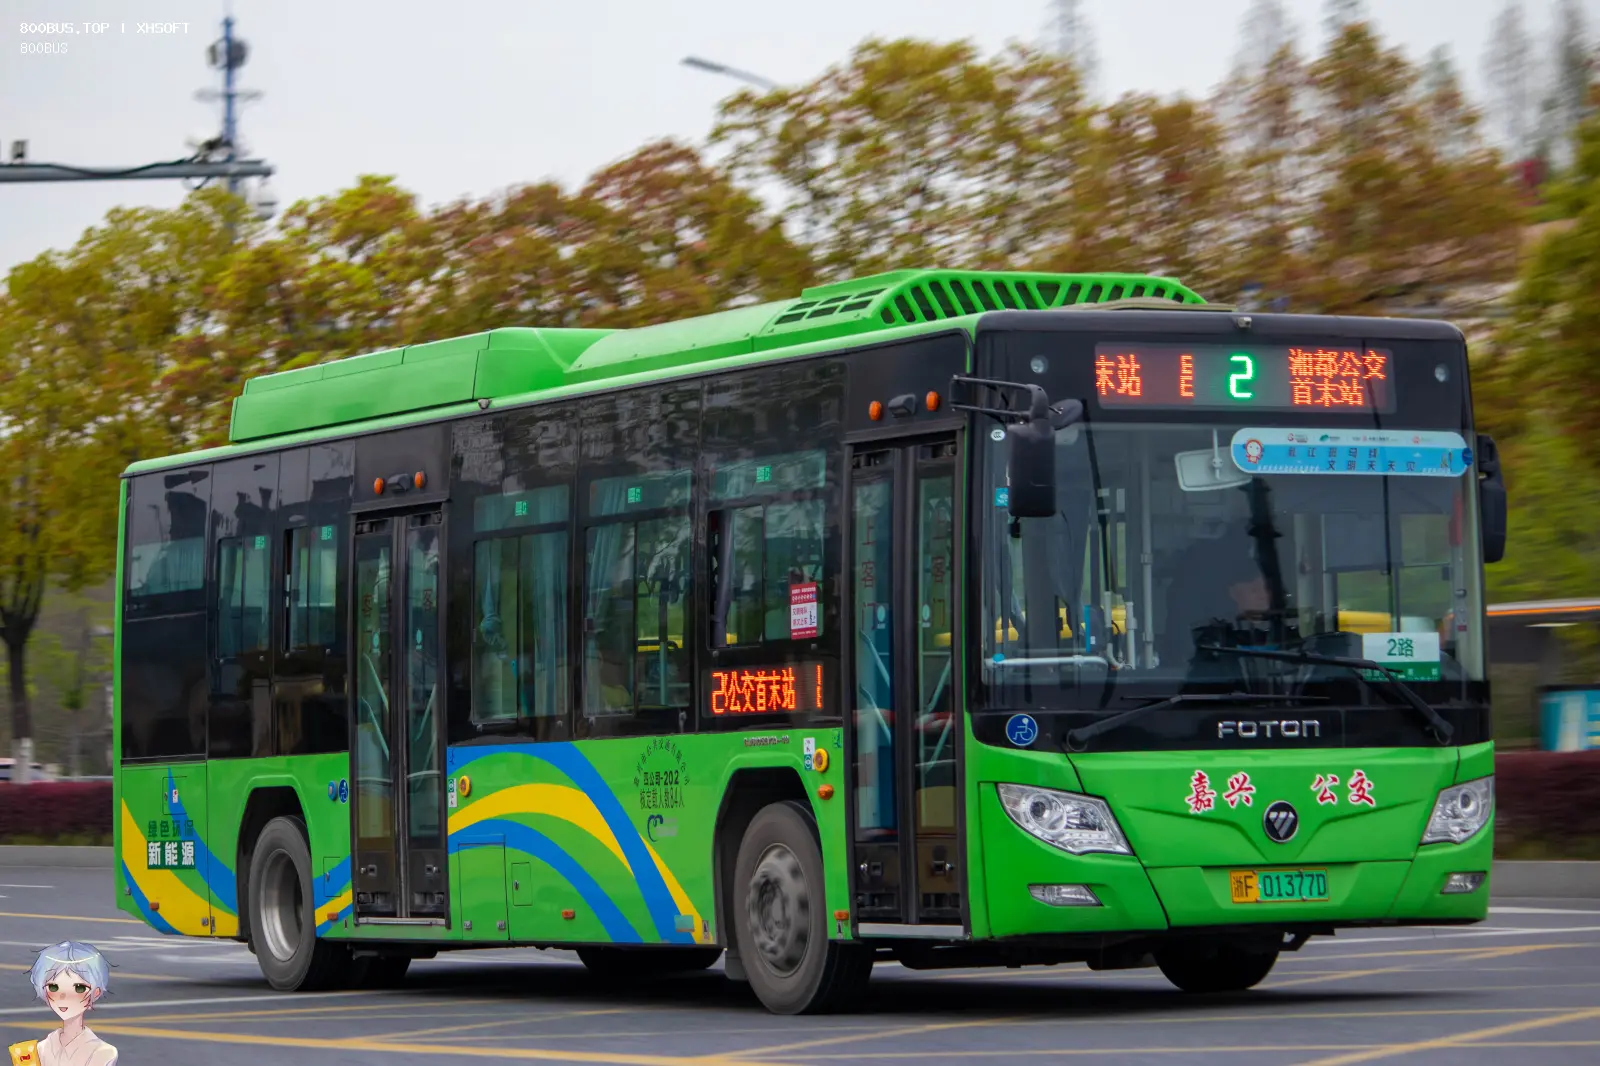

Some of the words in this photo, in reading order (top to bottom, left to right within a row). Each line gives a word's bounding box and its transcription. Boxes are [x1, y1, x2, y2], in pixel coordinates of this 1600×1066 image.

[1228, 354, 1254, 398] 2
[1288, 377, 1365, 408] 首末站
[1325, 459, 1417, 473] 文明天天见
[1386, 637, 1415, 658] 2路
[1217, 719, 1320, 739] FOTON
[1185, 769, 1257, 815] 嘉兴
[1310, 769, 1376, 808] 公交
[147, 819, 194, 838] 绿色环保
[147, 840, 195, 866] 新能源
